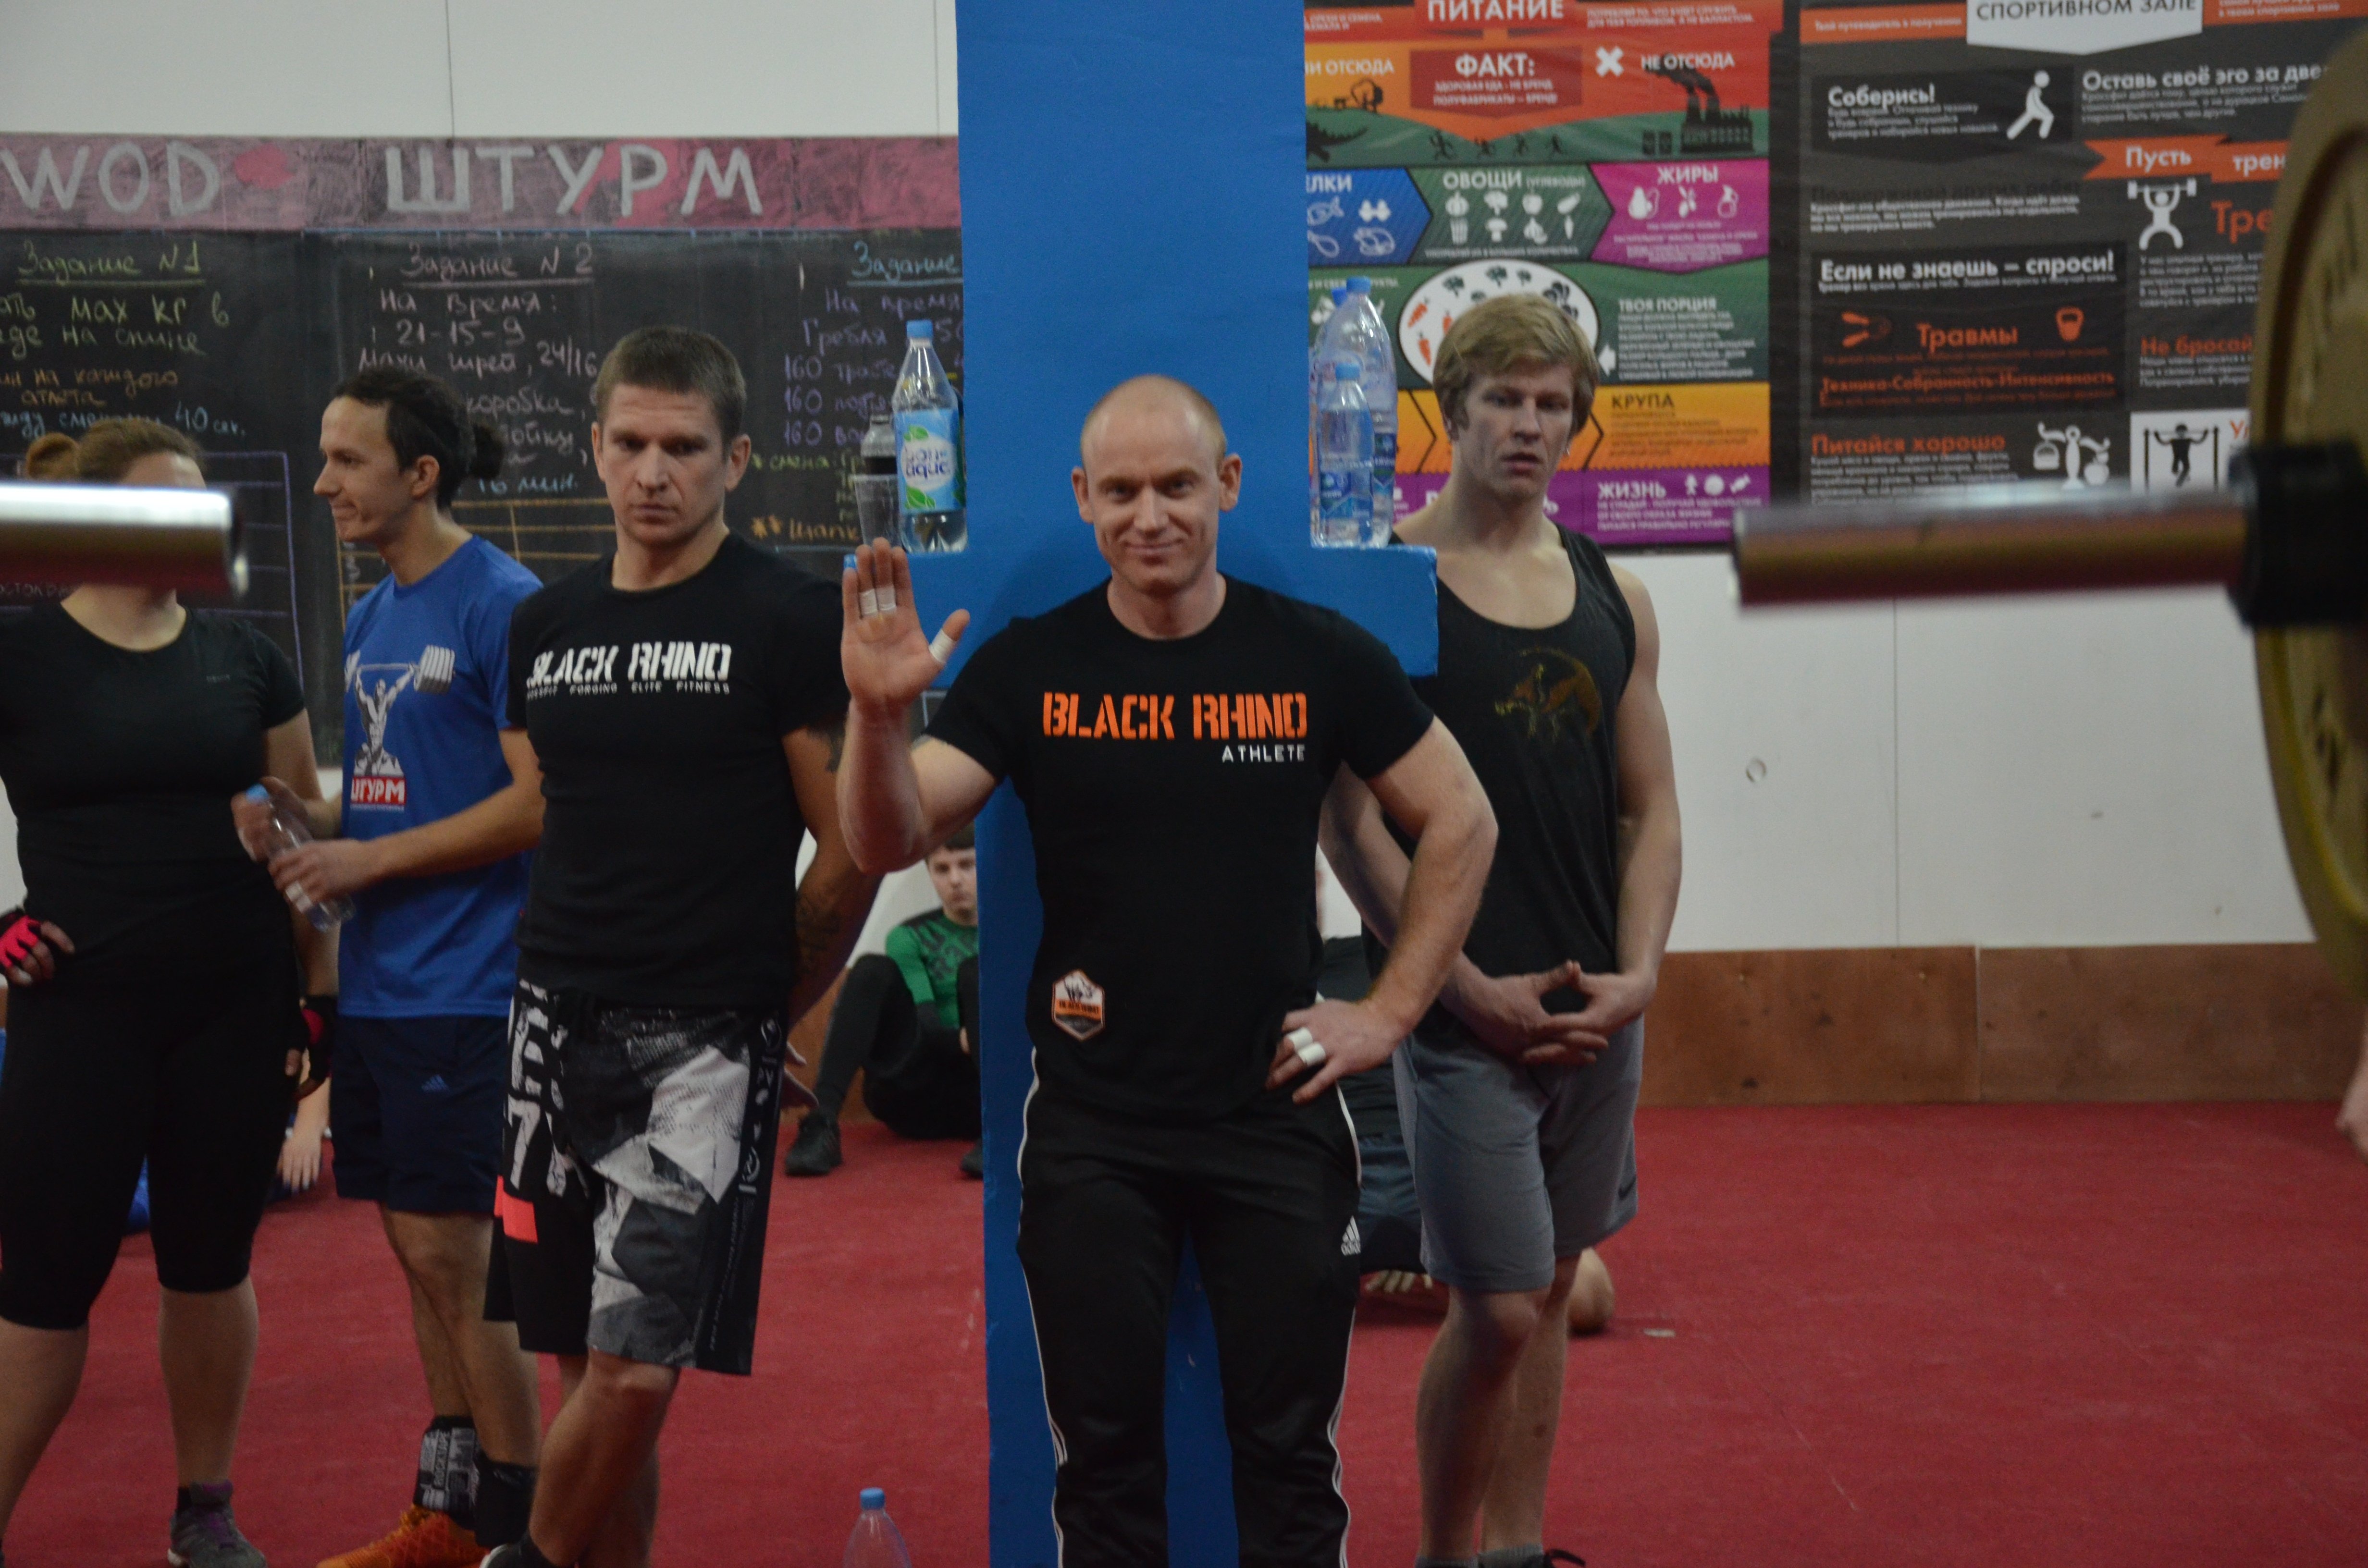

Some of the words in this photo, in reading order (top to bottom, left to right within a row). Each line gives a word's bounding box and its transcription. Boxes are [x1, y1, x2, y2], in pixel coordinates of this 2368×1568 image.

[1428, 0, 1565, 22] ПИТАНИЕ
[1976, 0, 2134, 20] СПОРТИВНОМ
[1326, 58, 1394, 76] ОТСЮДА
[1455, 53, 1536, 77] ФАКТ:
[1641, 55, 1660, 71] НЕ
[1663, 51, 1736, 70] ОТСЮДА
[2082, 70, 2157, 91] Оставь
[2162, 65, 2210, 86] своё
[2215, 68, 2249, 86] эго
[2255, 67, 2279, 84] за
[2284, 63, 2329, 85] две
[1828, 82, 1936, 110] Соберись!
[2125, 145, 2192, 173] Пусть
[0, 141, 221, 218] WOD
[386, 145, 763, 218] ШТУРМ
[1443, 170, 1523, 191] ОВОЩИ
[1657, 165, 1719, 185] ЖИРЫ
[1820, 259, 1873, 282] Если
[1877, 262, 1906, 281] не
[1912, 258, 1999, 280] знаешь
[2025, 249, 2114, 281] спроси!
[1656, 296, 1717, 313] ПОРЦИЯ
[1916, 323, 2018, 355] Травмы
[1611, 392, 1675, 411] КРУПА
[1811, 434, 1905, 455] Питайся
[1912, 434, 2006, 456] хорошо
[1597, 480, 1667, 500] ЖИЗНЬ
[628, 641, 732, 682] RHINO
[570, 682, 617, 696] FORGING
[631, 680, 663, 694] ELITE
[676, 680, 730, 695] FITNESS
[1042, 691, 1176, 740] BLACK
[1193, 691, 1307, 740] RHINO
[1221, 744, 1306, 763] ATHLETE
